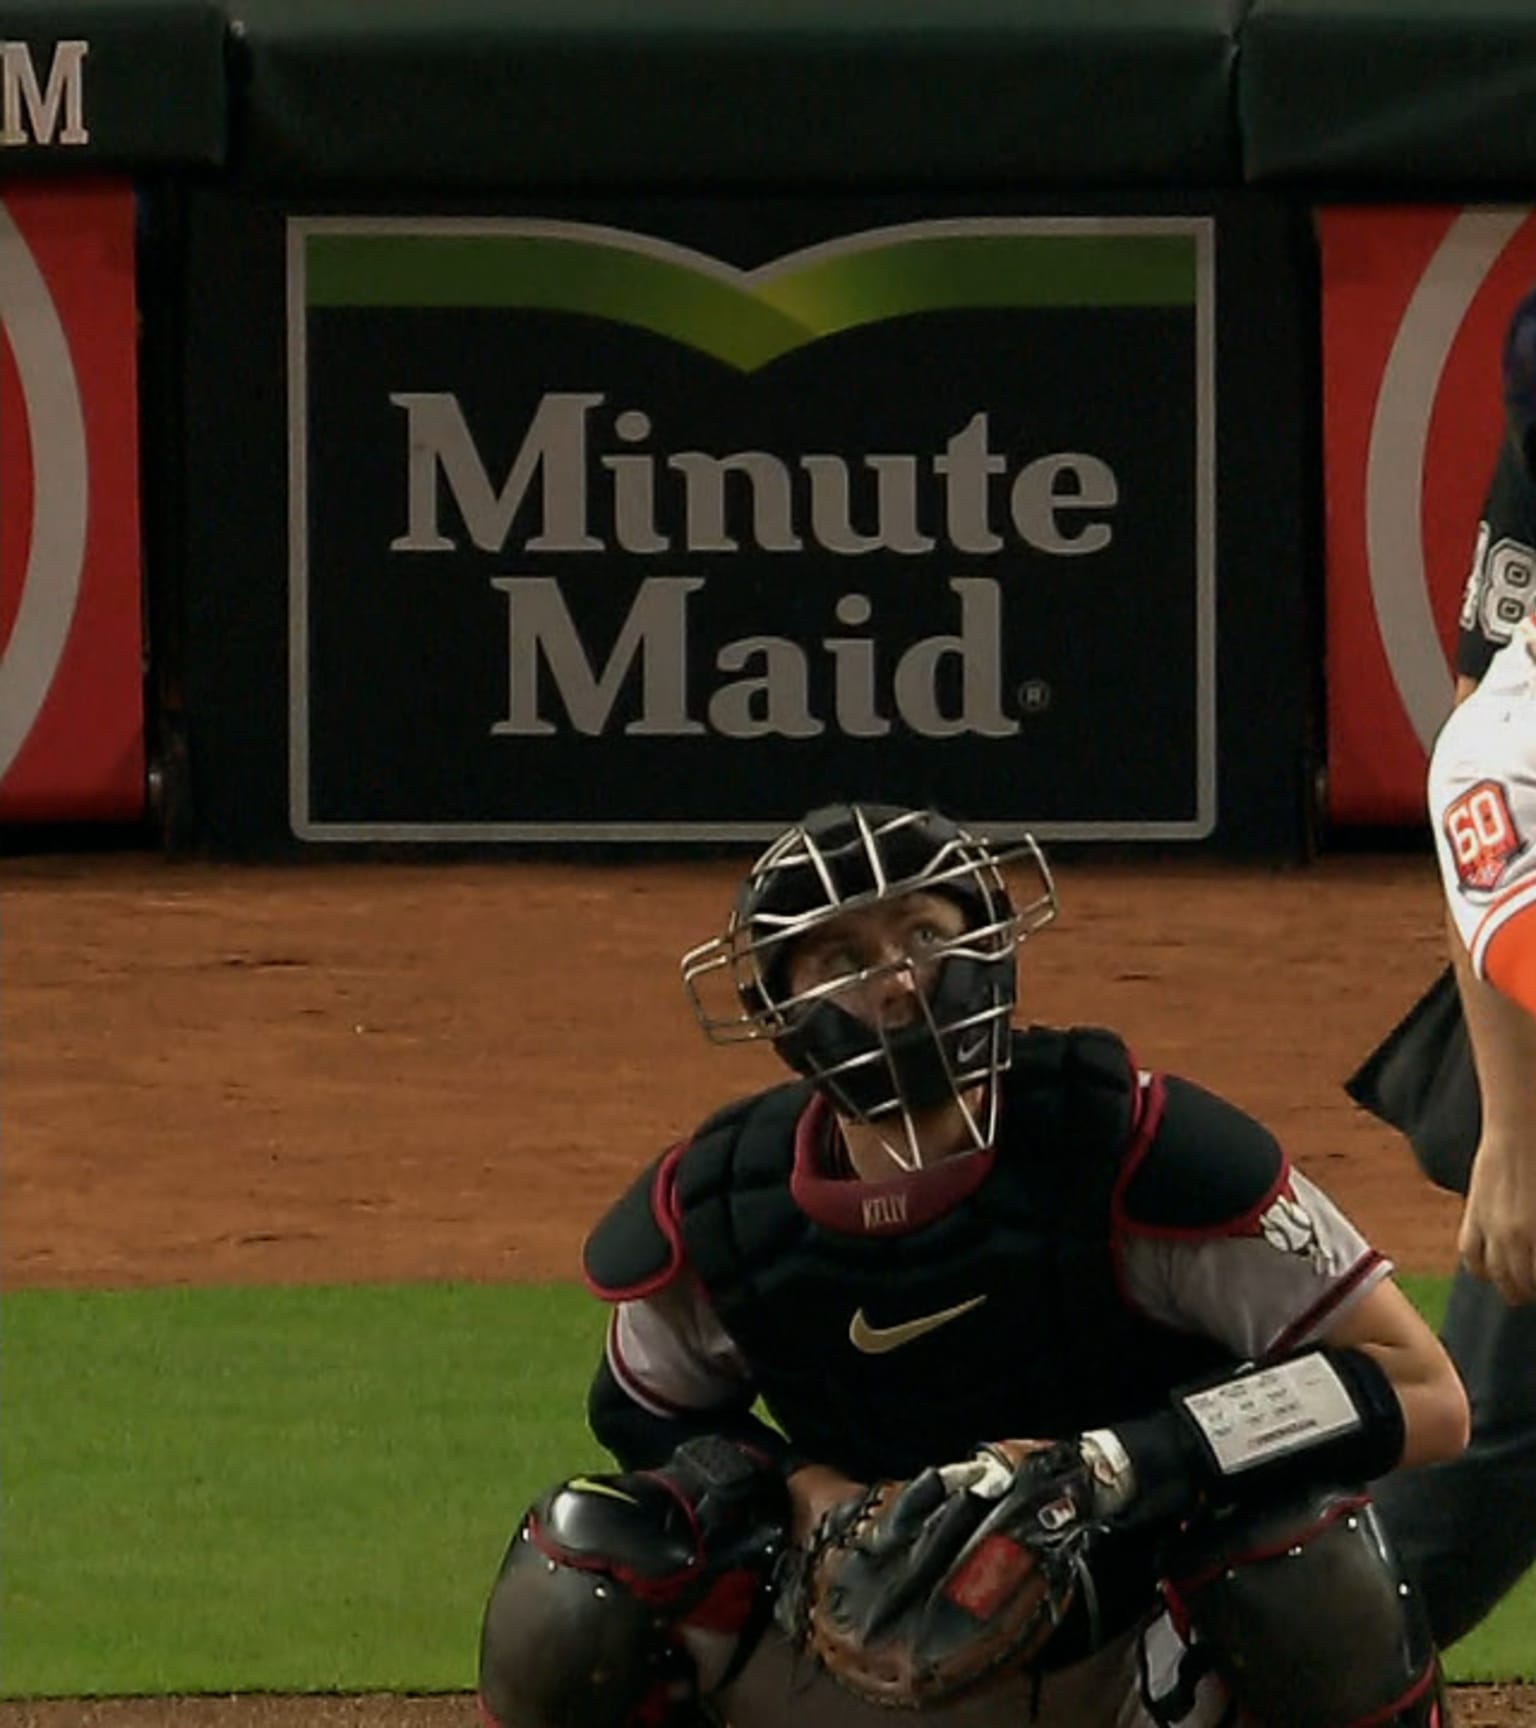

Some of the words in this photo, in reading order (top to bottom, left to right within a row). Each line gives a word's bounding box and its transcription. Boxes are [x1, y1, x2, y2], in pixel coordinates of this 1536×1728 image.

[389, 392, 1119, 554] Minute
[1447, 788, 1506, 865] 60
[861, 1192, 908, 1231] KELLY
